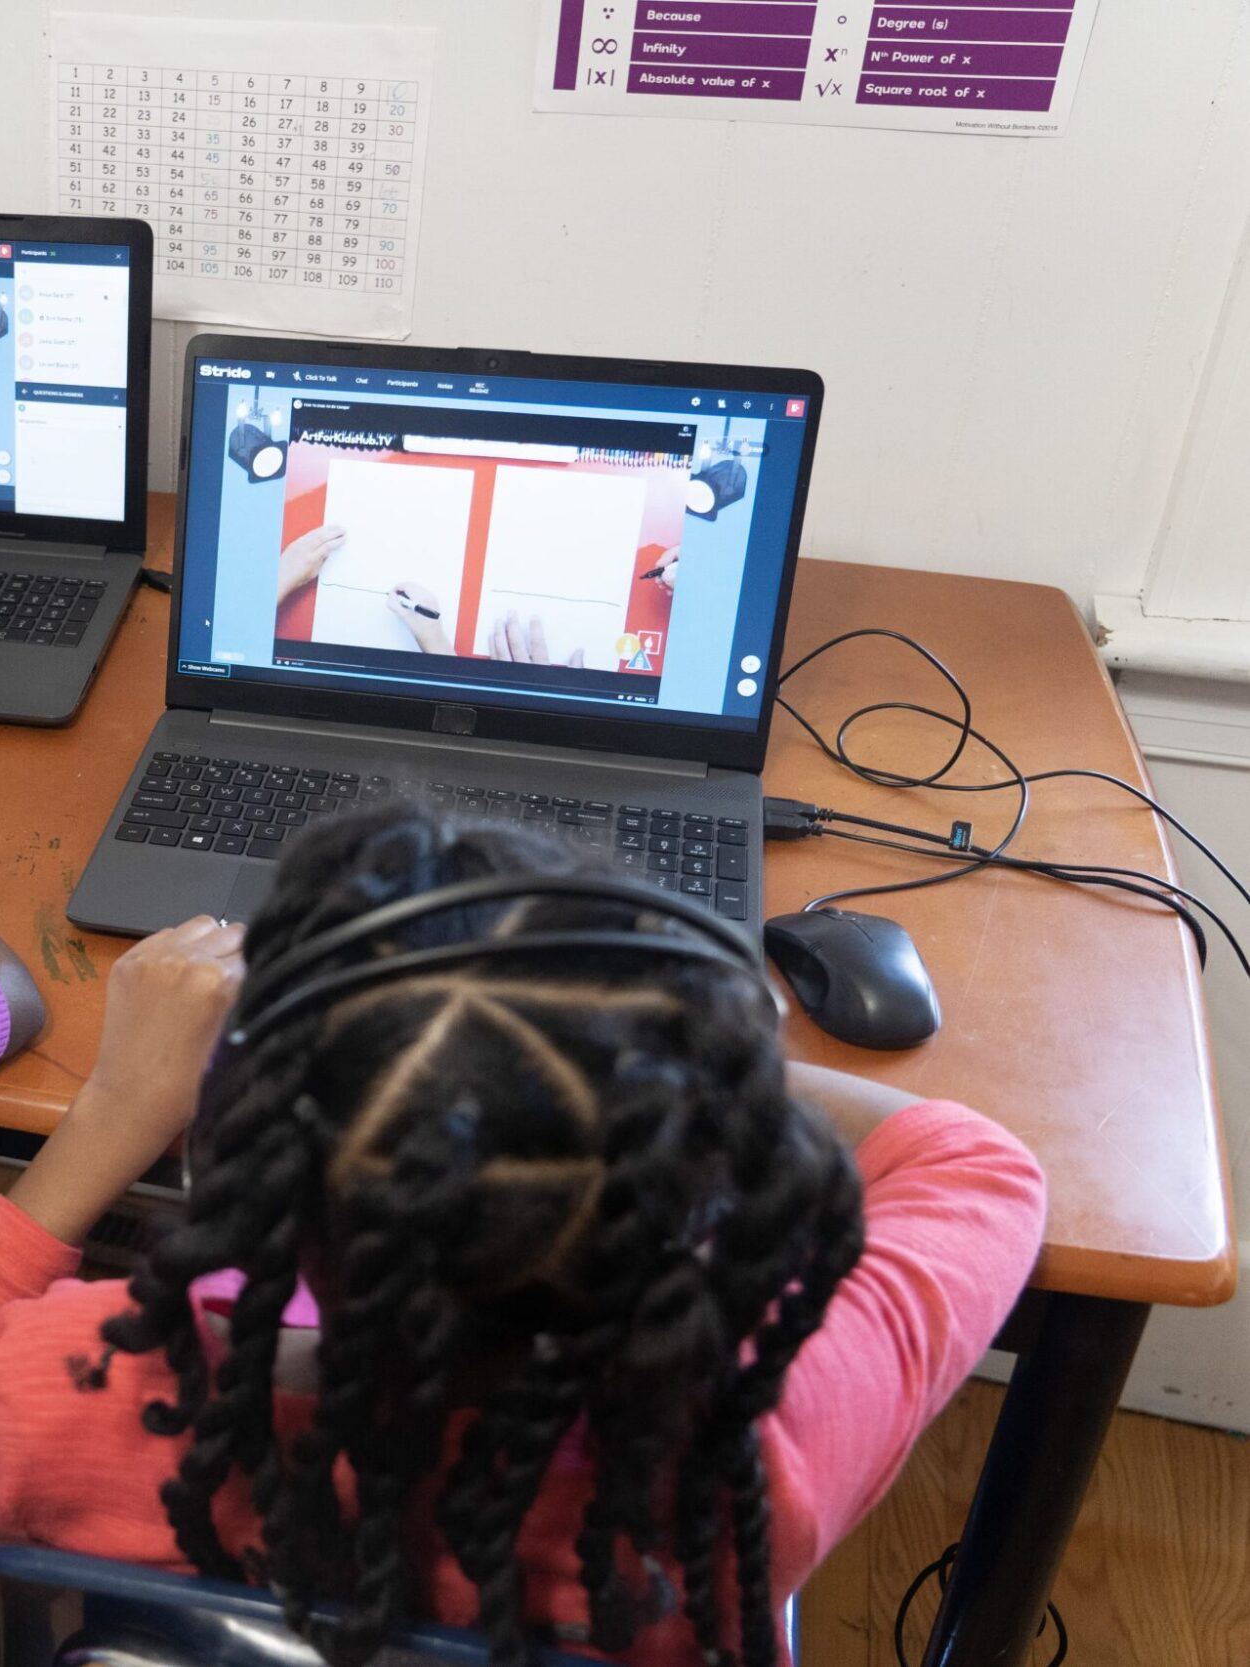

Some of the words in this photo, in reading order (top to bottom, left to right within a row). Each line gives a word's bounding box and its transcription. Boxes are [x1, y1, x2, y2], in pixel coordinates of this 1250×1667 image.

[647, 10, 701, 22] Because
[877, 17, 926, 31] Degree
[932, 18, 948, 30] (s)
[642, 42, 686, 57] Infinity
[892, 52, 934, 64] Power
[940, 53, 956, 64] of
[962, 56, 971, 64] x
[640, 73, 695, 85] Absolute
[702, 75, 735, 87] value
[742, 77, 756, 88] of
[762, 80, 771, 88] x
[864, 83, 912, 96] Square
[918, 85, 948, 97] root
[954, 87, 970, 98] of
[976, 89, 986, 98] x
[70, 86, 81, 98] 11
[104, 88, 116, 100] 12
[138, 90, 151, 102] 13
[173, 92, 186, 104] 14
[208, 94, 221, 106] 15
[244, 96, 257, 109] 16
[280, 98, 293, 110] 17
[316, 100, 330, 113] 18
[353, 102, 367, 115] 19
[389, 104, 406, 117] 20
[69, 105, 82, 117] 21
[102, 106, 117, 119] 22
[137, 109, 151, 122] 23
[171, 111, 186, 123] 24
[241, 115, 257, 128] 26
[278, 118, 293, 130] 27
[314, 120, 329, 133] 28
[350, 122, 367, 134] 29
[388, 124, 404, 137] 30
[69, 124, 82, 136] 31
[102, 126, 117, 138] 32
[137, 128, 151, 141] 33
[171, 130, 186, 142] 34
[241, 135, 256, 148] 36
[277, 137, 293, 149] 37
[313, 139, 328, 152] 38
[349, 141, 365, 154] 39
[69, 143, 82, 155] 41
[102, 144, 117, 157] 42
[136, 147, 151, 159] 43
[170, 149, 185, 160] 44
[205, 152, 220, 164] 45
[240, 154, 255, 167] 46
[275, 157, 291, 169] 47
[311, 159, 327, 171] 48
[347, 161, 364, 174] 49
[69, 161, 82, 173] 51
[102, 163, 116, 175] 52
[136, 166, 150, 178] 53
[170, 168, 185, 180] 54
[239, 173, 254, 186] 56
[275, 175, 291, 188] 57
[310, 178, 326, 191] 58
[346, 180, 363, 193] 59
[69, 180, 82, 192] 61
[101, 182, 116, 194] 62
[135, 185, 150, 197] 63
[169, 187, 184, 199] 64
[203, 190, 219, 202] 65
[238, 192, 254, 204] 66
[273, 195, 290, 206] 67
[309, 198, 325, 209] 68
[345, 199, 361, 212] 69
[382, 202, 398, 215] 70
[69, 198, 82, 210] 71
[101, 200, 116, 212] 72
[135, 203, 150, 215] 73
[169, 205, 183, 217] 74
[204, 208, 219, 220] 75
[238, 210, 253, 223] 76
[273, 213, 289, 225] 77
[309, 216, 324, 228] 78
[345, 218, 360, 230] 79
[169, 223, 183, 235] 84
[238, 228, 253, 241] 86
[272, 231, 288, 243] 87
[307, 234, 323, 246] 88
[343, 236, 359, 249] 89
[379, 239, 395, 252] 90
[168, 241, 183, 253] 94
[237, 247, 252, 259] 96
[271, 250, 287, 261] 97
[306, 252, 322, 265] 98
[342, 255, 358, 268] 99
[375, 259, 396, 271] 100
[166, 259, 185, 271] 104
[234, 264, 253, 278] 106
[268, 267, 289, 280] 107
[303, 270, 323, 284] 108
[338, 274, 359, 287] 109
[374, 276, 394, 289] 110
[200, 364, 251, 379] Stride
[355, 377, 368, 385] Chat
[386, 379, 419, 388] Participants
[300, 430, 392, 446] ArtForKidsHub.TV
